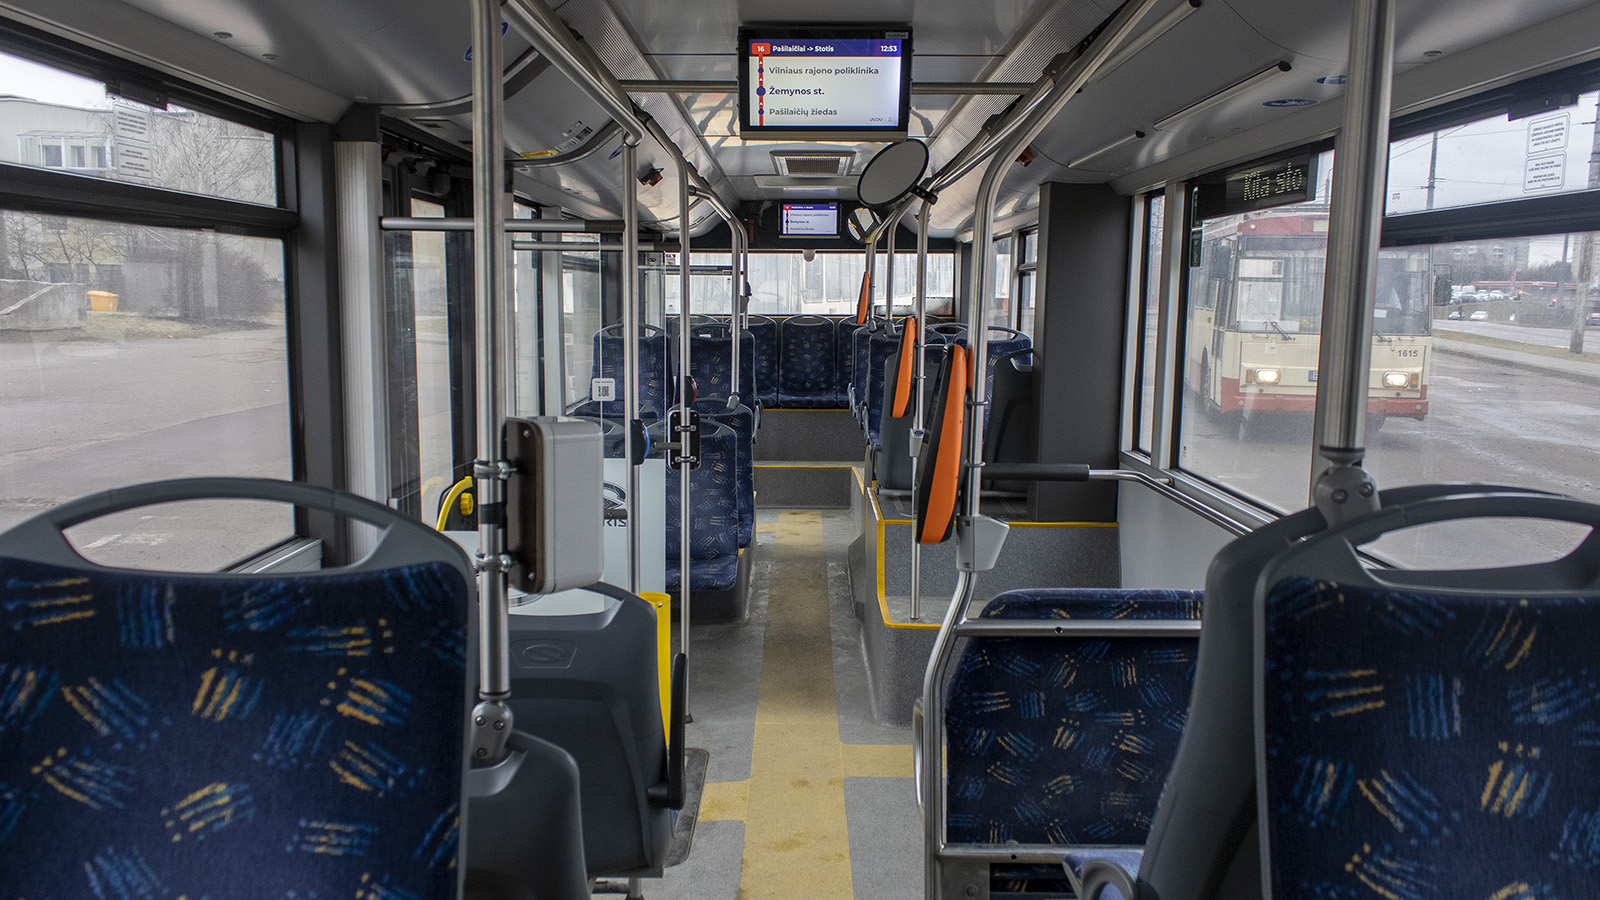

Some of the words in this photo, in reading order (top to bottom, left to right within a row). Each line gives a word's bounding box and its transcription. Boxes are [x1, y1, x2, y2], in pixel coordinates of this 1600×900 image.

[769, 66, 803, 74] Vilniaus
[804, 66, 832, 76] rajono
[834, 66, 879, 76] poliklinika
[769, 86, 811, 96] Žemynos
[769, 108, 809, 116] Pašilaičių
[810, 108, 838, 116] žiedas
[1244, 170, 1270, 200] Kita
[1275, 162, 1302, 194] sto
[1397, 349, 1418, 357] 1615
